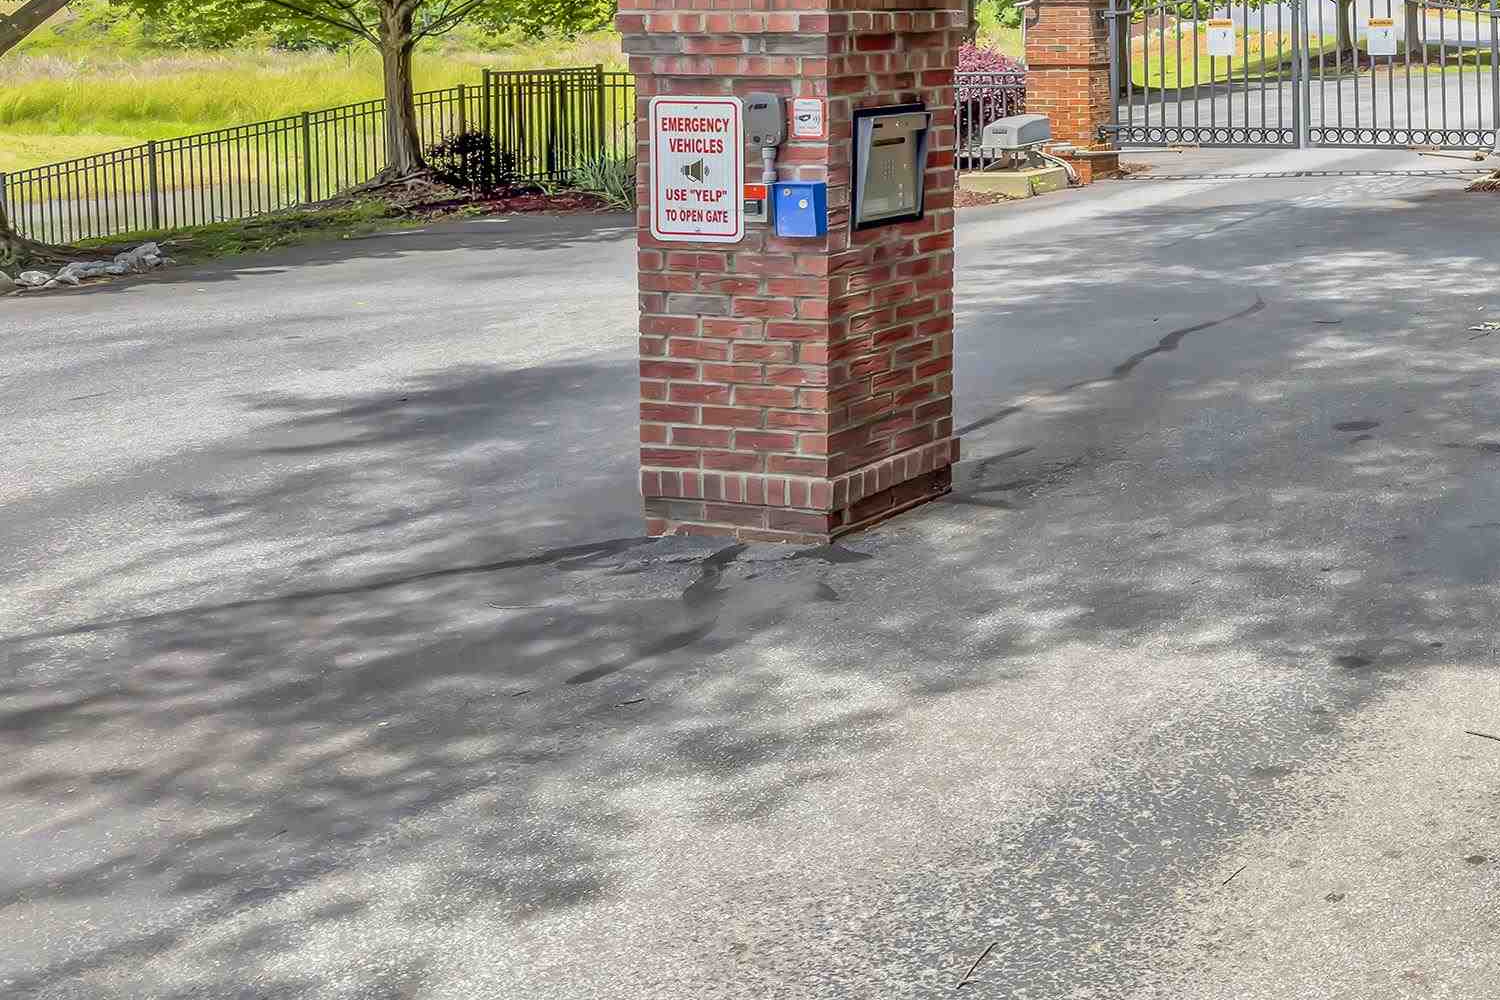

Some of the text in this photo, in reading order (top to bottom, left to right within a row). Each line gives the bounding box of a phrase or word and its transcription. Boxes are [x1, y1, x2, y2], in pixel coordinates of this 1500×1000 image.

[661, 117, 730, 133] EMERGENCY
[669, 138, 724, 154] VEHICLES
[665, 188, 728, 202] USE "YELP"
[665, 209, 729, 223] TO OPEN GATE
